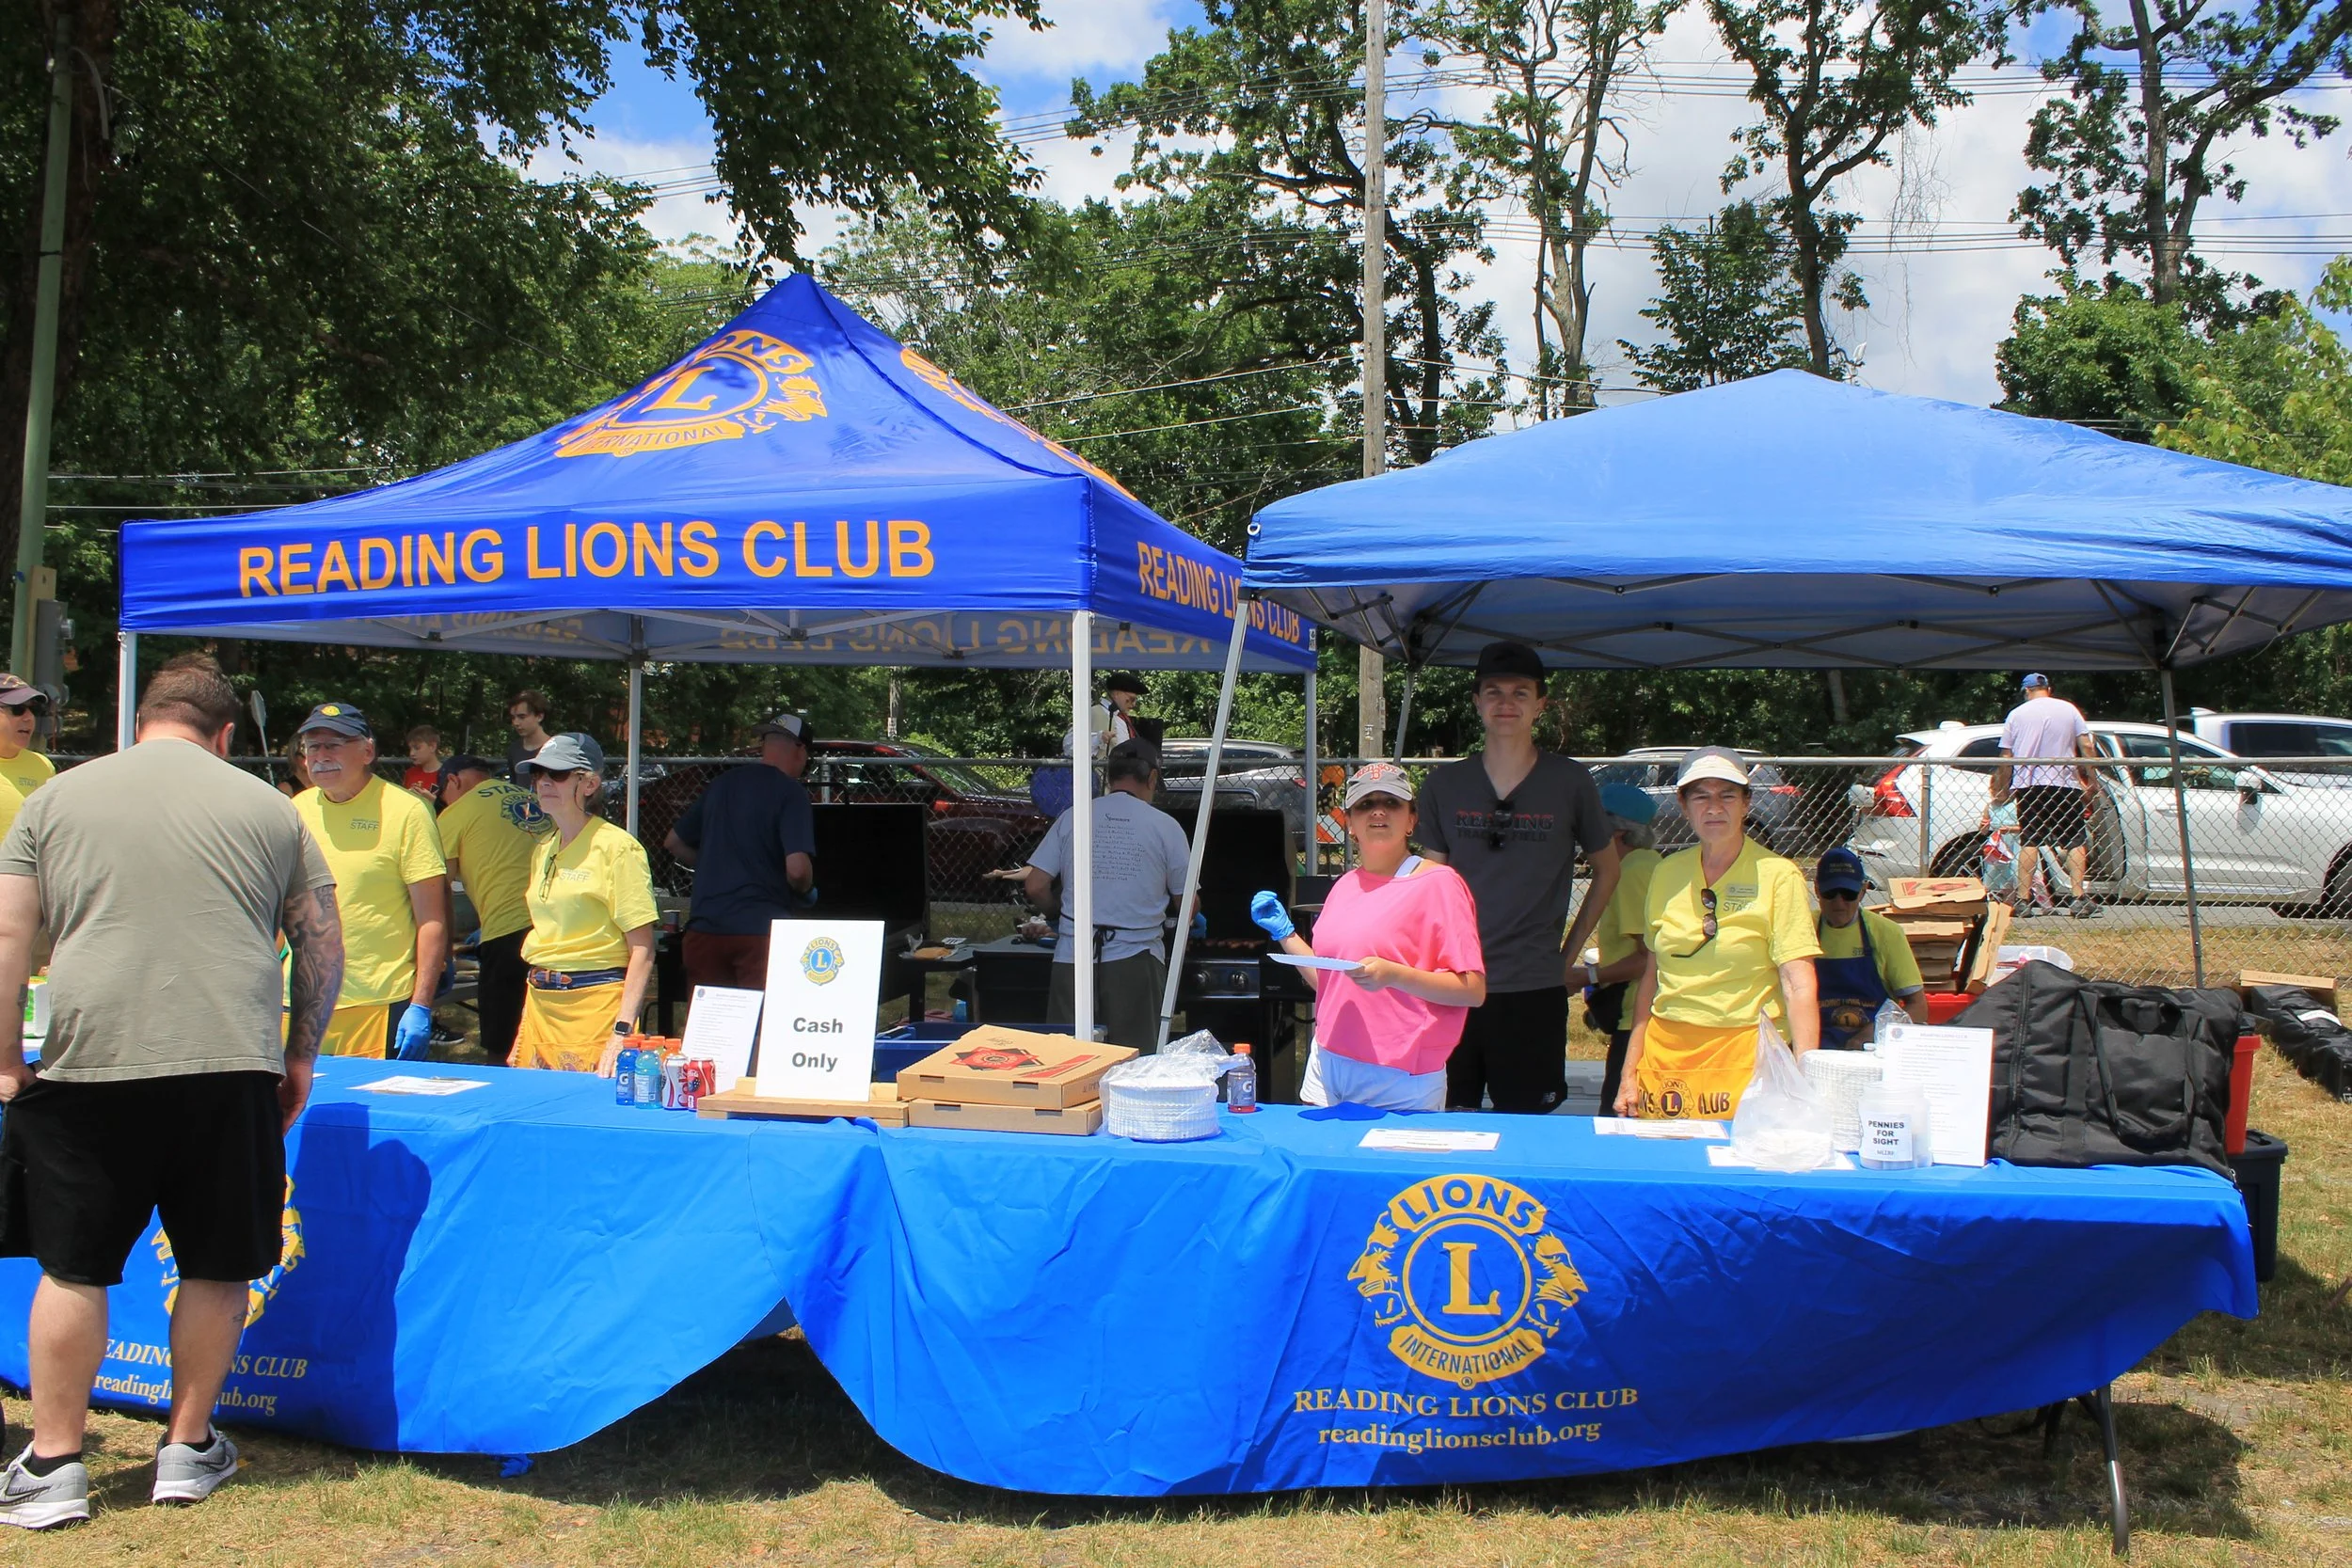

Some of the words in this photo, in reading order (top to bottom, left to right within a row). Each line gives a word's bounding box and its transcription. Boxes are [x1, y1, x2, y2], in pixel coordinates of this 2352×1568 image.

[640, 366, 718, 414] L
[239, 528, 503, 597] READING
[527, 521, 720, 579] LIONS
[742, 520, 934, 578] CLUB
[1136, 541, 1219, 614] READING
[1267, 601, 1300, 644] CLUB
[519, 801, 540, 818] L
[351, 821, 380, 832] STAFF
[1455, 811, 1555, 832] REAING
[559, 872, 591, 882] STAFF
[810, 939, 835, 949] LIONS
[816, 951, 829, 968] L
[793, 1017, 844, 1034] Cash
[791, 1052, 838, 1072] Only
[619, 1073, 629, 1085] G
[1243, 1081, 1253, 1093] G
[1664, 1092, 1678, 1113] L
[1867, 1120, 1905, 1129] PENNIES
[1397, 1179, 1537, 1230] LIONS
[1441, 1242, 1502, 1315] L
[1399, 1332, 1535, 1375] INTERNATIONAL
[254, 1355, 308, 1379] CLUB
[1294, 1389, 1438, 1418] READING
[1450, 1390, 1547, 1418] LIONS
[1555, 1387, 1639, 1410] CLUB
[1318, 1419, 1602, 1455] readinglionsclub.org
